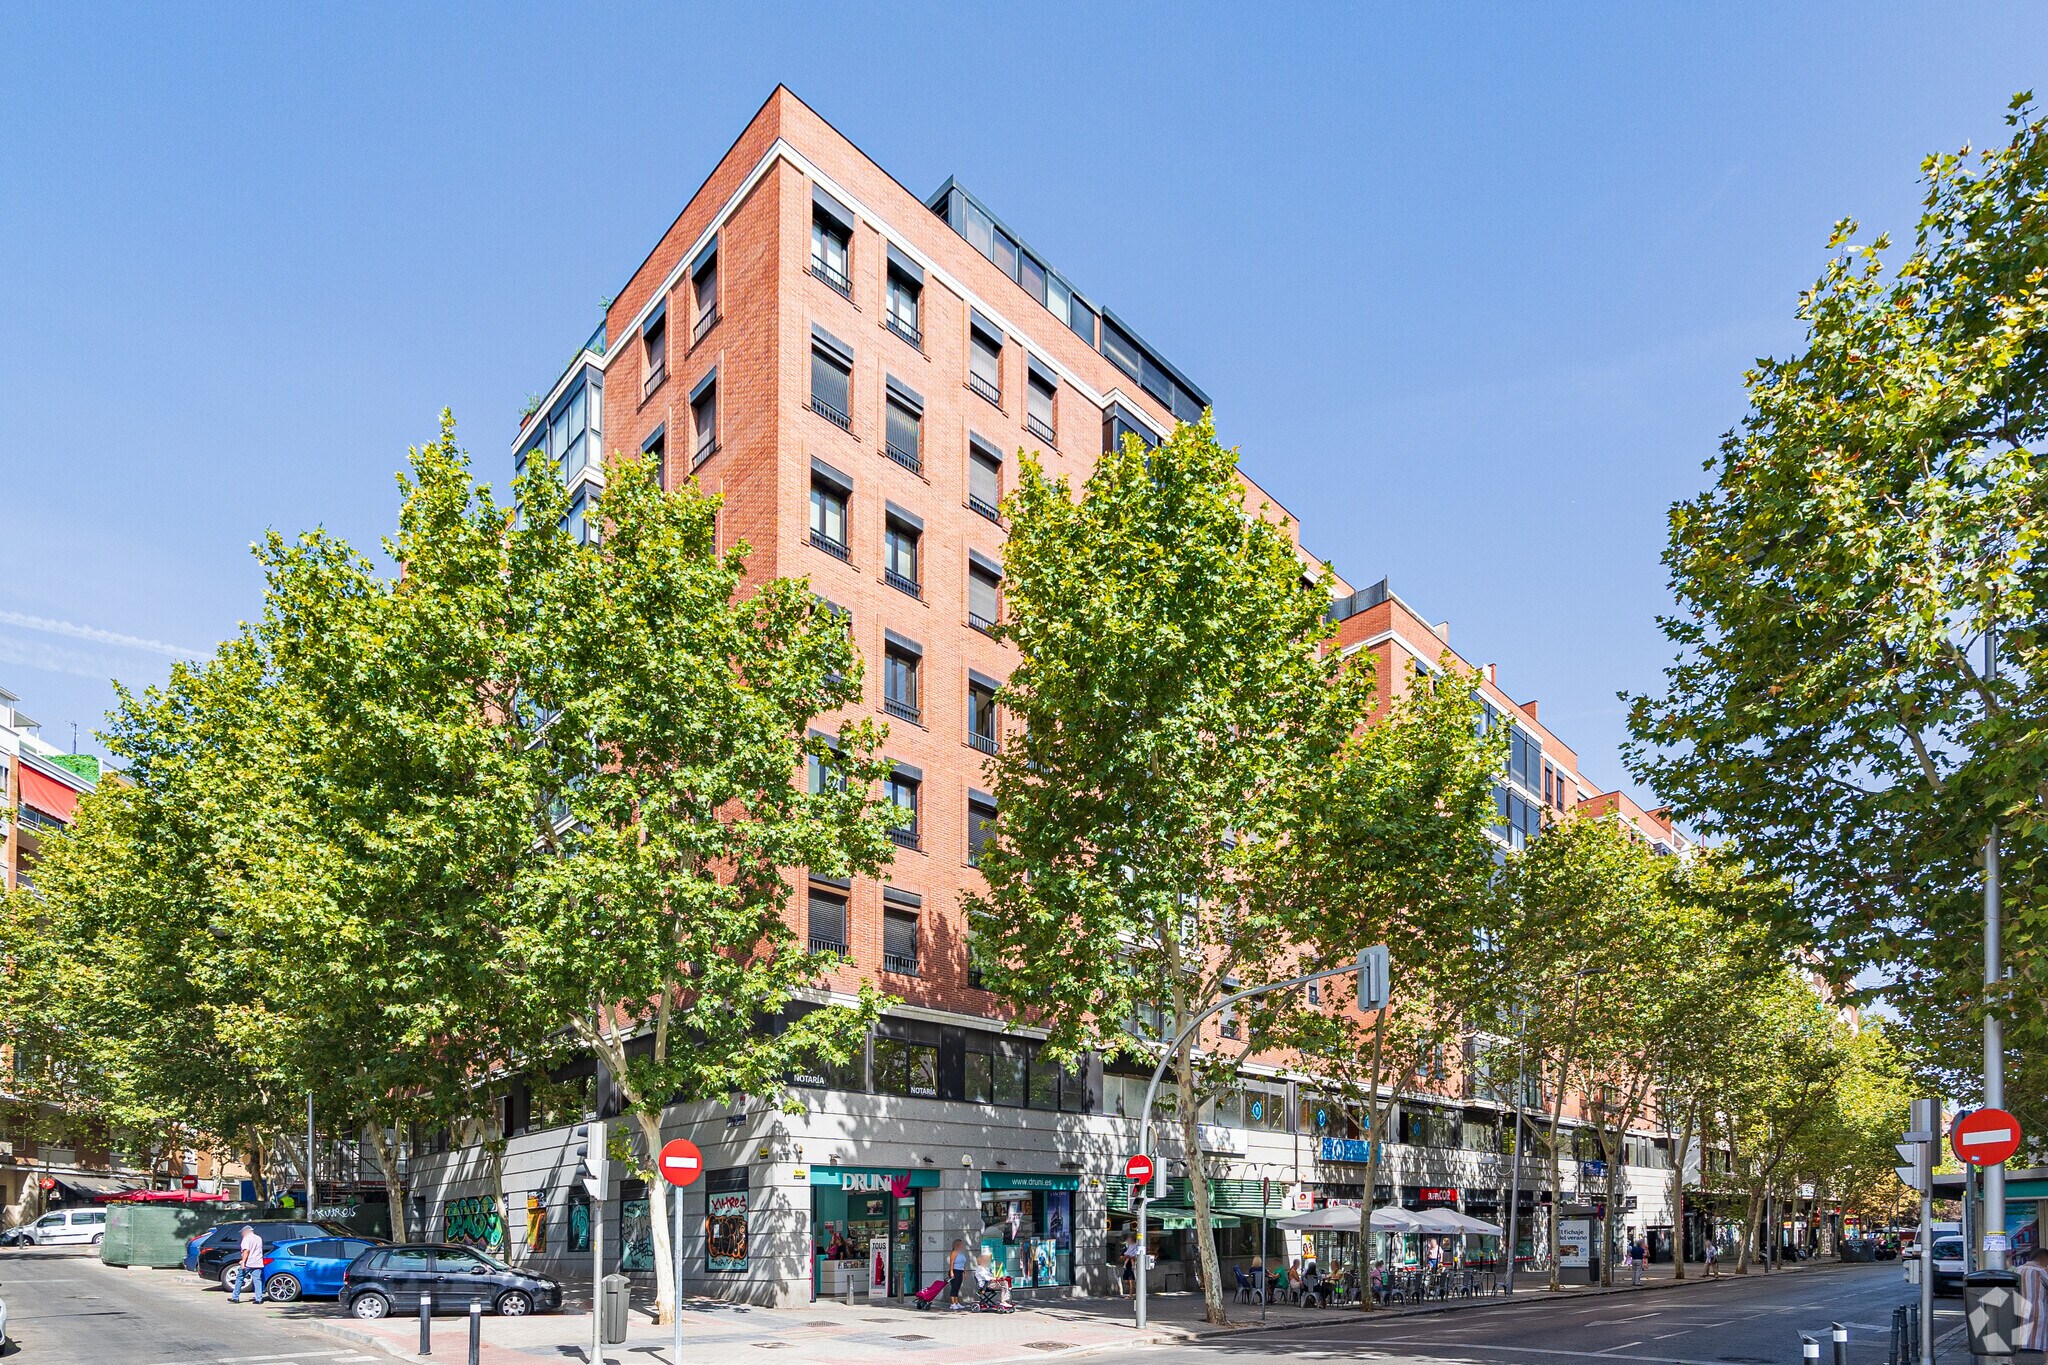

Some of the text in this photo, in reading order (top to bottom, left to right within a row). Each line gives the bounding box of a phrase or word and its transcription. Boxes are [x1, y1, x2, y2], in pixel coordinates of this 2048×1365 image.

[794, 1074, 825, 1085] NOTARÍA
[910, 1086, 937, 1096] NOTARÍA
[842, 1173, 892, 1191] DRUNI
[1012, 1178, 1052, 1186] www.druni.es
